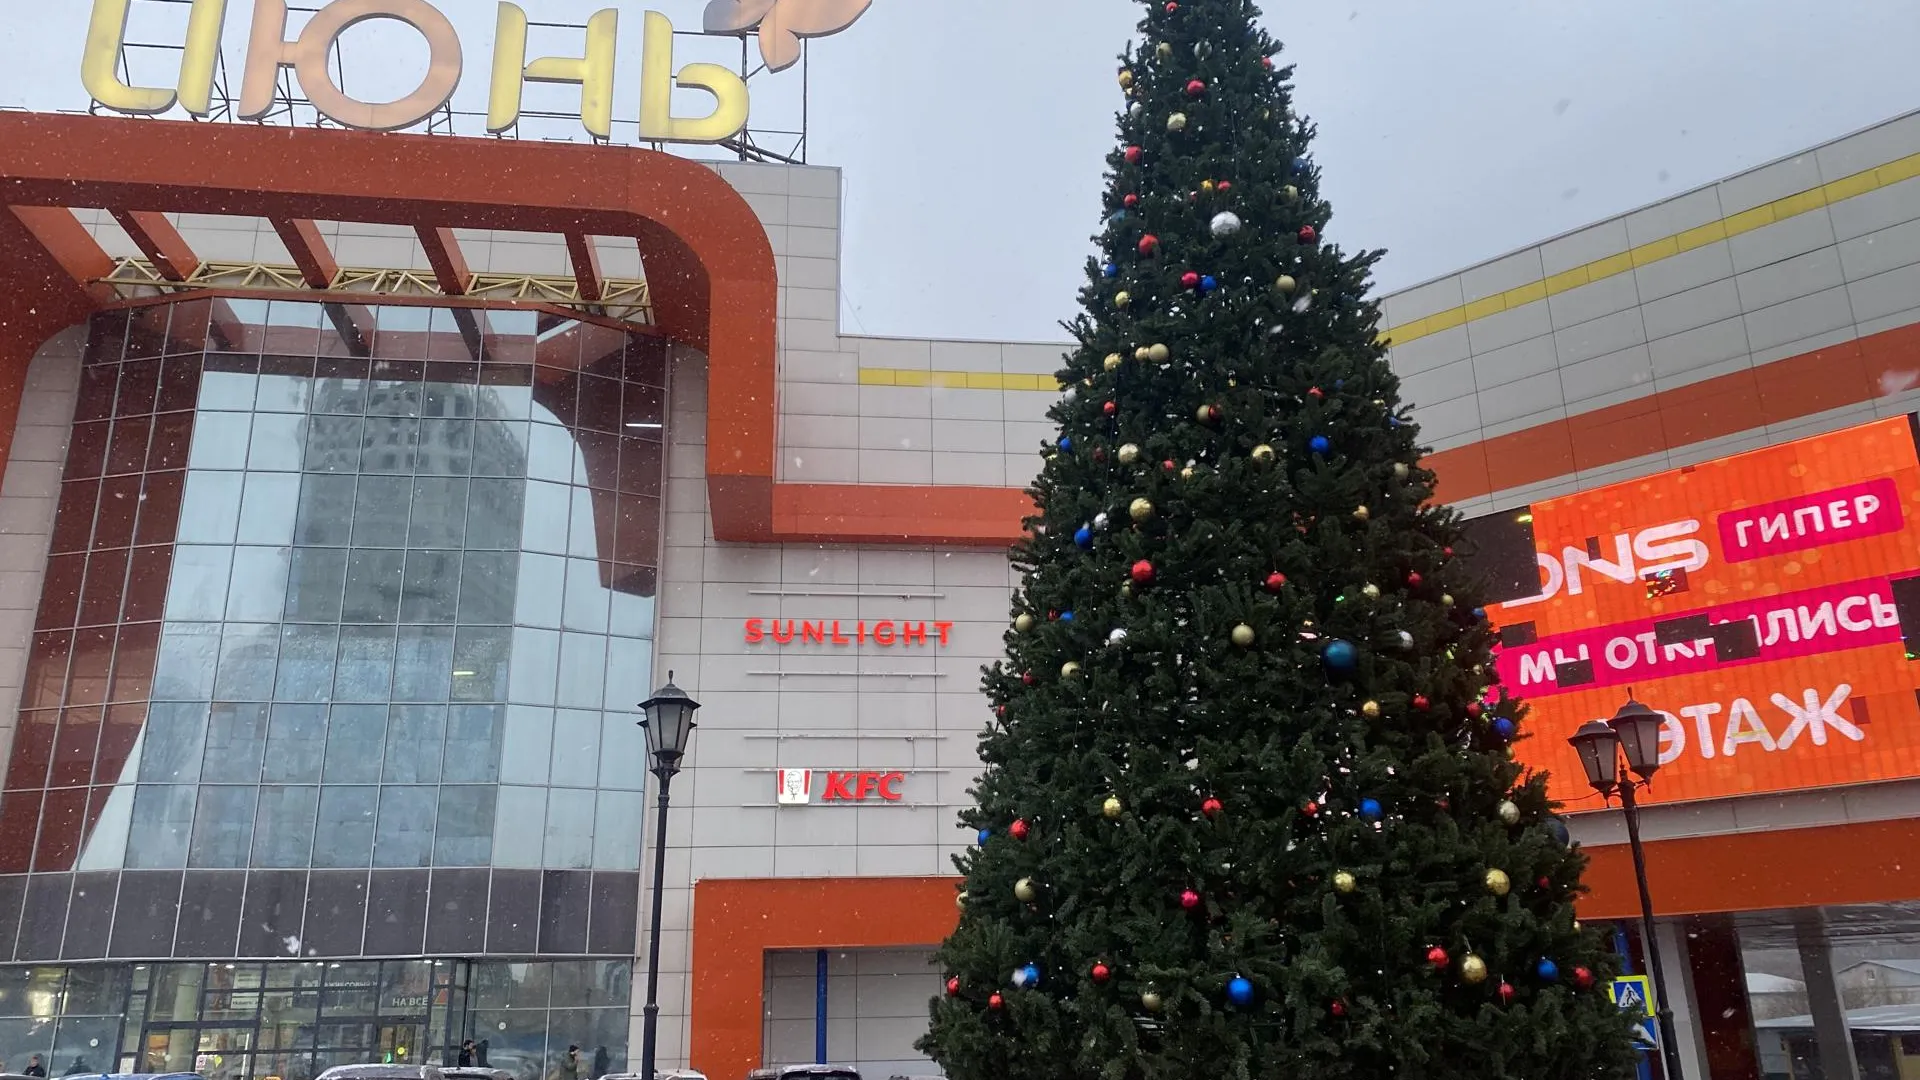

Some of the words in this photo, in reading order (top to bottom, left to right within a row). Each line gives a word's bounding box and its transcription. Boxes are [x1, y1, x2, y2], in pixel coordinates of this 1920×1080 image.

[81, 0, 750, 144] ИЮНЬ
[1736, 494, 1880, 548] ГИПЕР
[743, 617, 954, 647] SUNLIGHT
[1605, 595, 1900, 670] ОТКЛИСЬ
[821, 771, 905, 800] KFC
[392, 997, 407, 1007] НА
